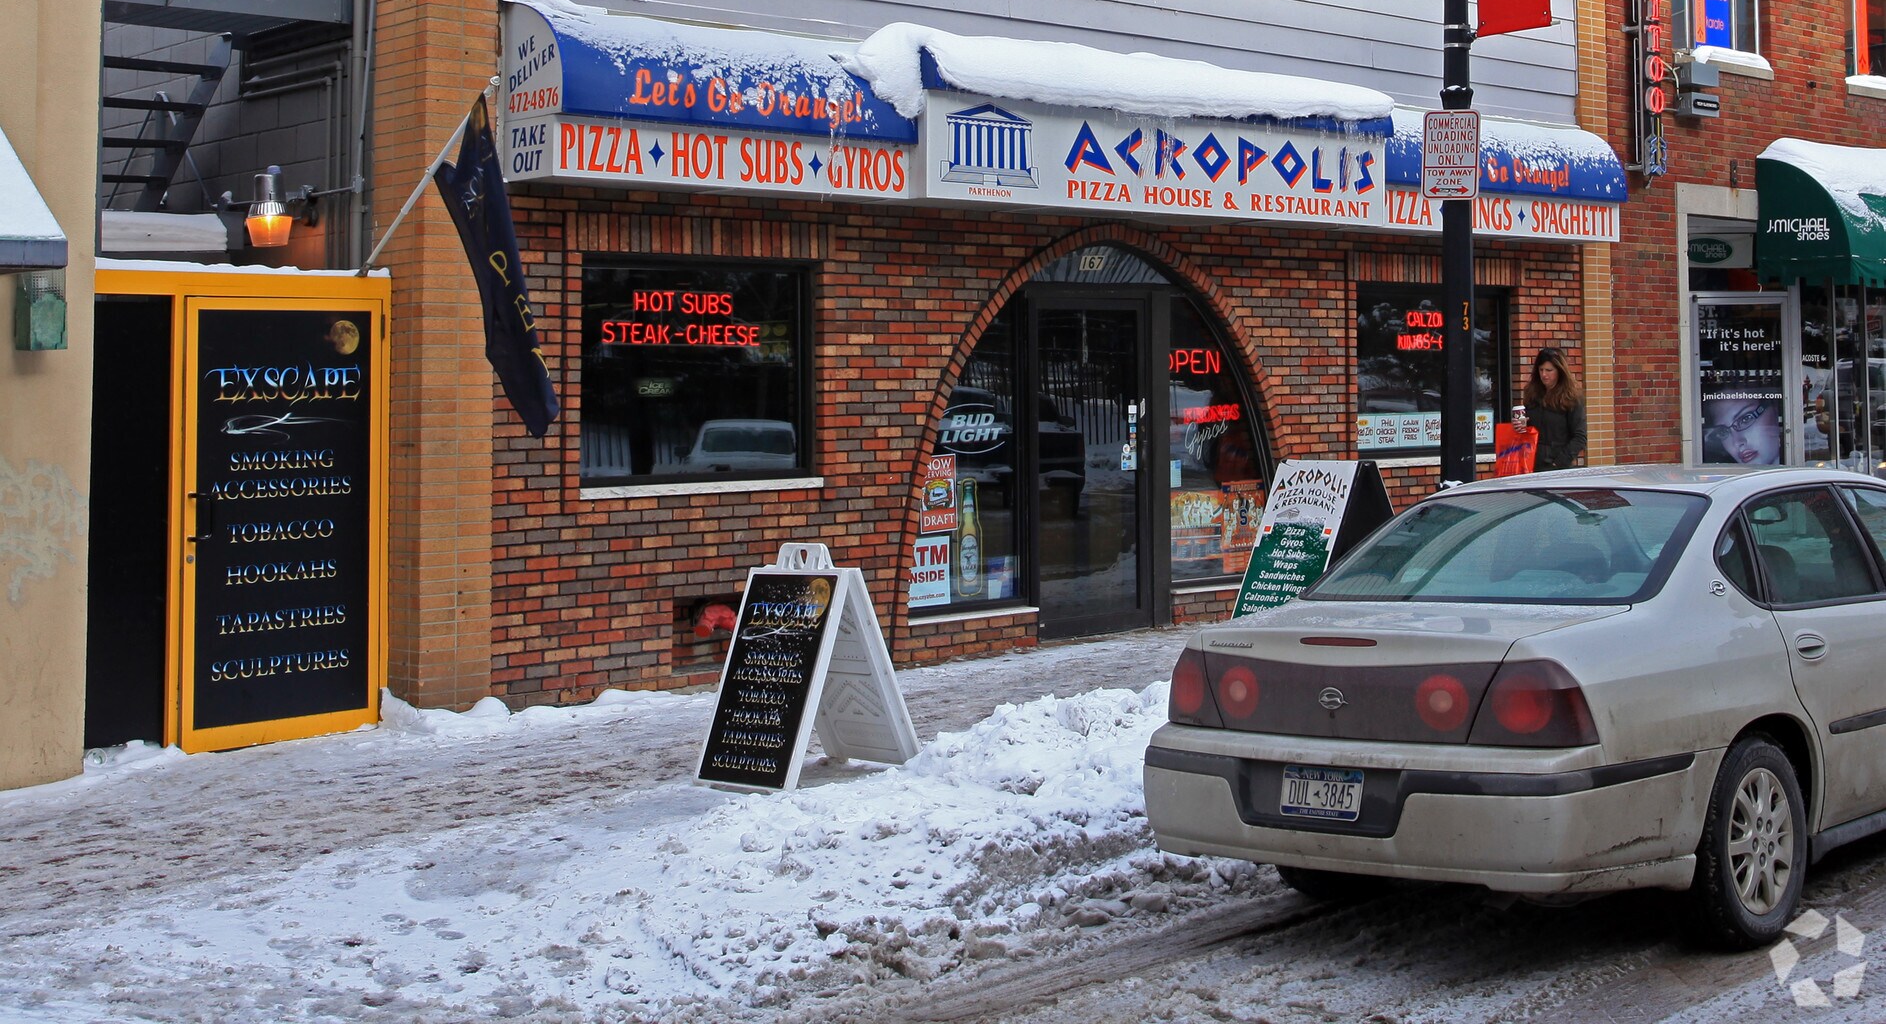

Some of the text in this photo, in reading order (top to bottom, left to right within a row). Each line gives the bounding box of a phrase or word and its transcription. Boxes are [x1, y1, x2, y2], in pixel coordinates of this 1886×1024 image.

[1706, 16, 1724, 30] karate
[518, 35, 536, 61] WE
[509, 43, 556, 94] DELIVER
[629, 69, 696, 108] Let's
[509, 86, 559, 114] 472-4876
[1428, 118, 1476, 130] COMMERCIAL
[511, 124, 546, 149] TAKE
[1431, 131, 1473, 141] LOADING
[1428, 143, 1475, 154] UNLOADING
[513, 149, 543, 174] OUT
[560, 123, 904, 193] PIZZA HOT SUBS GYROS
[1064, 120, 1376, 195] ACROPOLIS
[1438, 155, 1464, 165] ONLY
[968, 187, 1012, 198] PARTHENON
[1067, 179, 1370, 219] PIZZA HOUSE & RESTAURANT
[1385, 189, 1613, 237] IZZA INGS SPAGHETTI
[1797, 229, 1830, 241] shoes
[1082, 257, 1104, 269] 167
[634, 291, 733, 315] HOT SUBS
[1700, 328, 1764, 339] "If it's hot
[1720, 340, 1781, 351] it's here!"
[204, 362, 361, 405] EXSCAPE
[649, 380, 664, 388] ICE
[1703, 392, 1782, 401] jmichaelshoes.com
[950, 413, 994, 427] BUD
[1183, 404, 1240, 424] KRONOS
[1475, 422, 1490, 431] RAPS
[940, 428, 1002, 443] LIGHT
[1185, 418, 1228, 460] Gyros
[230, 449, 334, 472] SMOKING
[924, 469, 952, 479] ERVING
[211, 476, 352, 501] ACCESSORIES
[1272, 469, 1347, 499] ACROPOLIS
[1278, 488, 1337, 505] PIZZA HOUSE
[1281, 497, 1336, 515] RESTAURANT
[923, 513, 955, 527] DRAFT
[226, 519, 334, 544] TOBACCO
[1284, 527, 1306, 536] Pizza
[1280, 537, 1304, 547] Gyros
[1271, 548, 1306, 558] Hot Subs
[226, 558, 337, 586] HOOKAHS
[1273, 560, 1298, 570] Wraps
[907, 569, 945, 584] NSIDE
[1259, 571, 1306, 581] Sandwiches
[1251, 581, 1280, 591] Chicken
[1244, 592, 1278, 603] Calzones
[216, 604, 346, 636] TAPASTRIES
[211, 649, 350, 682] SCULPTURES
[744, 651, 799, 667] SMOKING
[733, 666, 802, 684] ACCESSORIES
[738, 690, 786, 705] TOBACCO
[731, 710, 781, 726] HOOKAHS
[721, 728, 784, 748] TAPASTRIES
[712, 754, 777, 773] SCULPTURES
[1303, 770, 1344, 782] NEW YORK
[1289, 780, 1355, 809] DUL 3845
